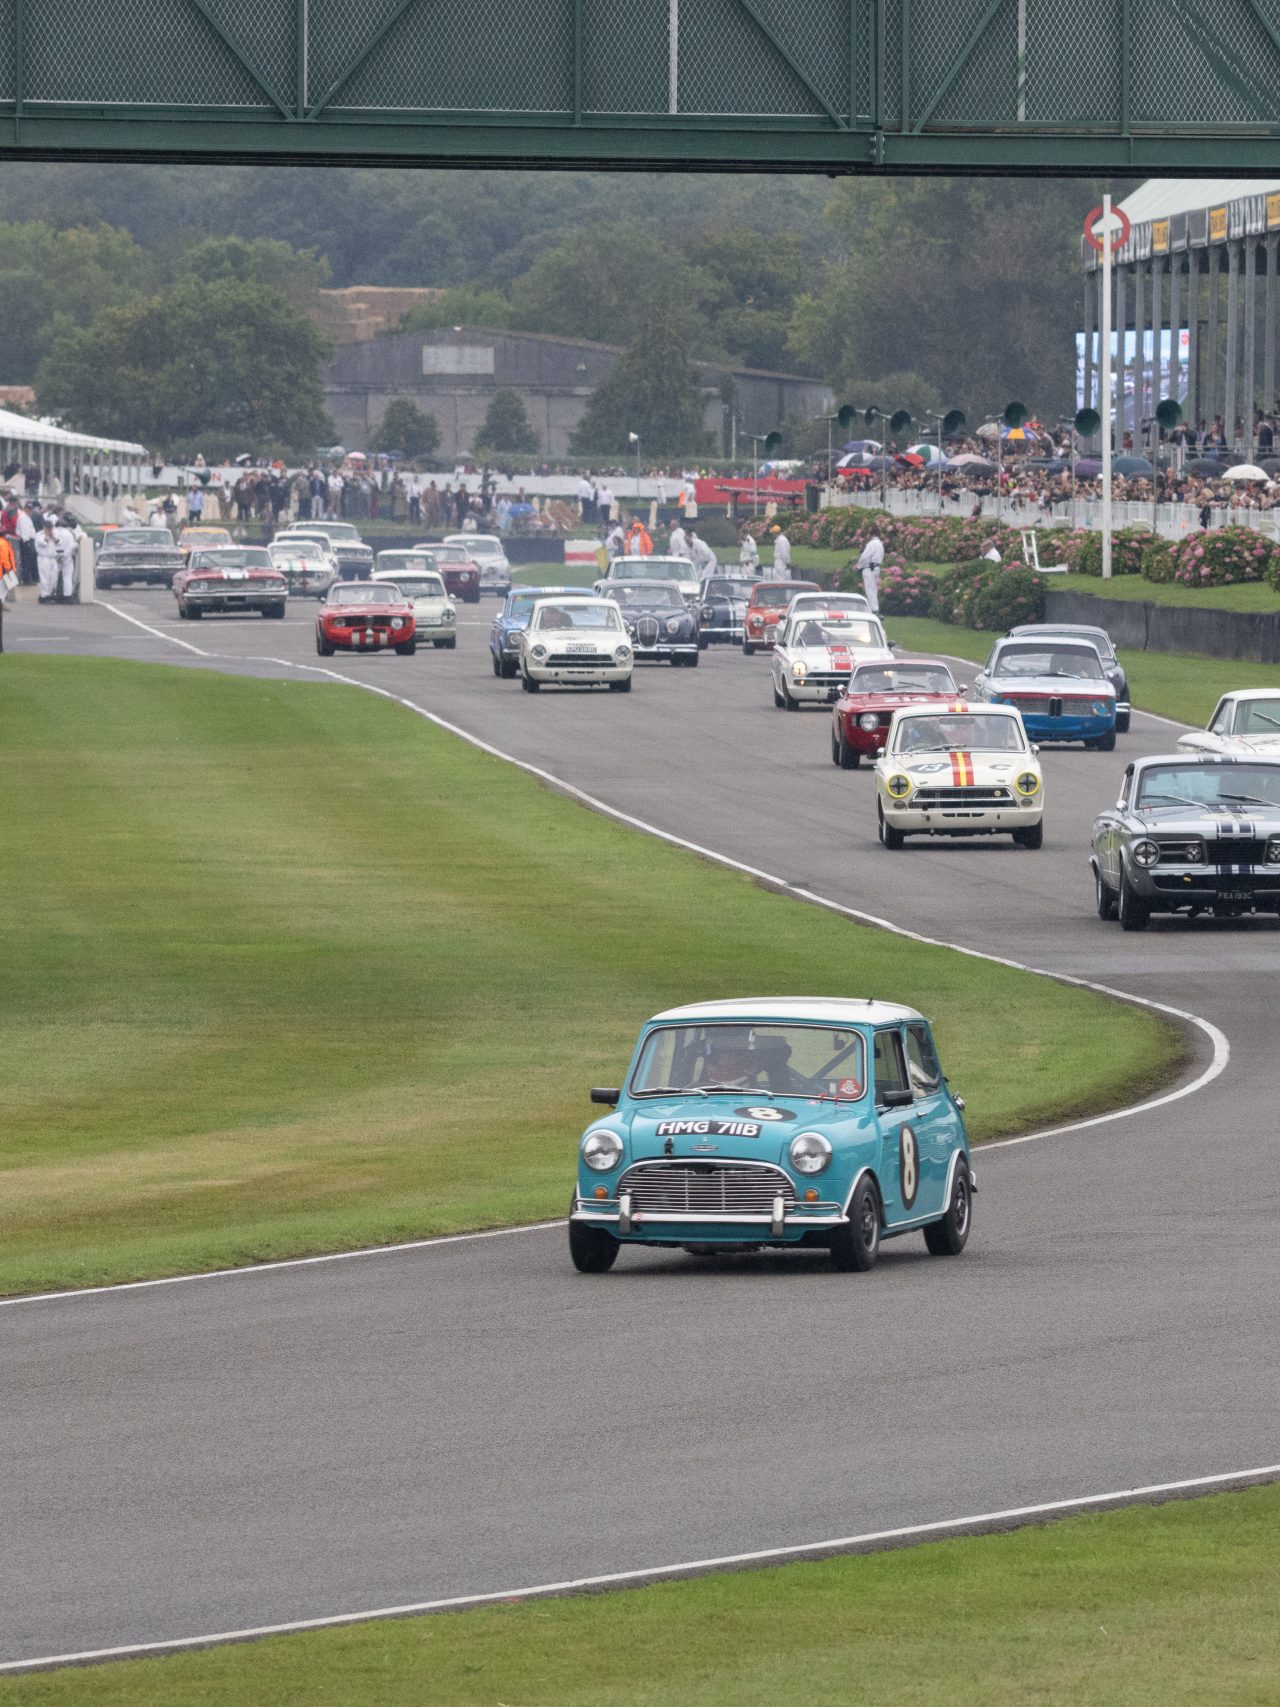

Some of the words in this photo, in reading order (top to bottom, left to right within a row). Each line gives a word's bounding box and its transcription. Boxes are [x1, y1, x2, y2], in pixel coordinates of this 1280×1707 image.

[919, 763, 943, 771] 13
[747, 1106, 784, 1121] 8
[658, 1121, 710, 1135] HMG
[717, 1121, 759, 1137] 711B
[902, 1127, 916, 1200] 8
